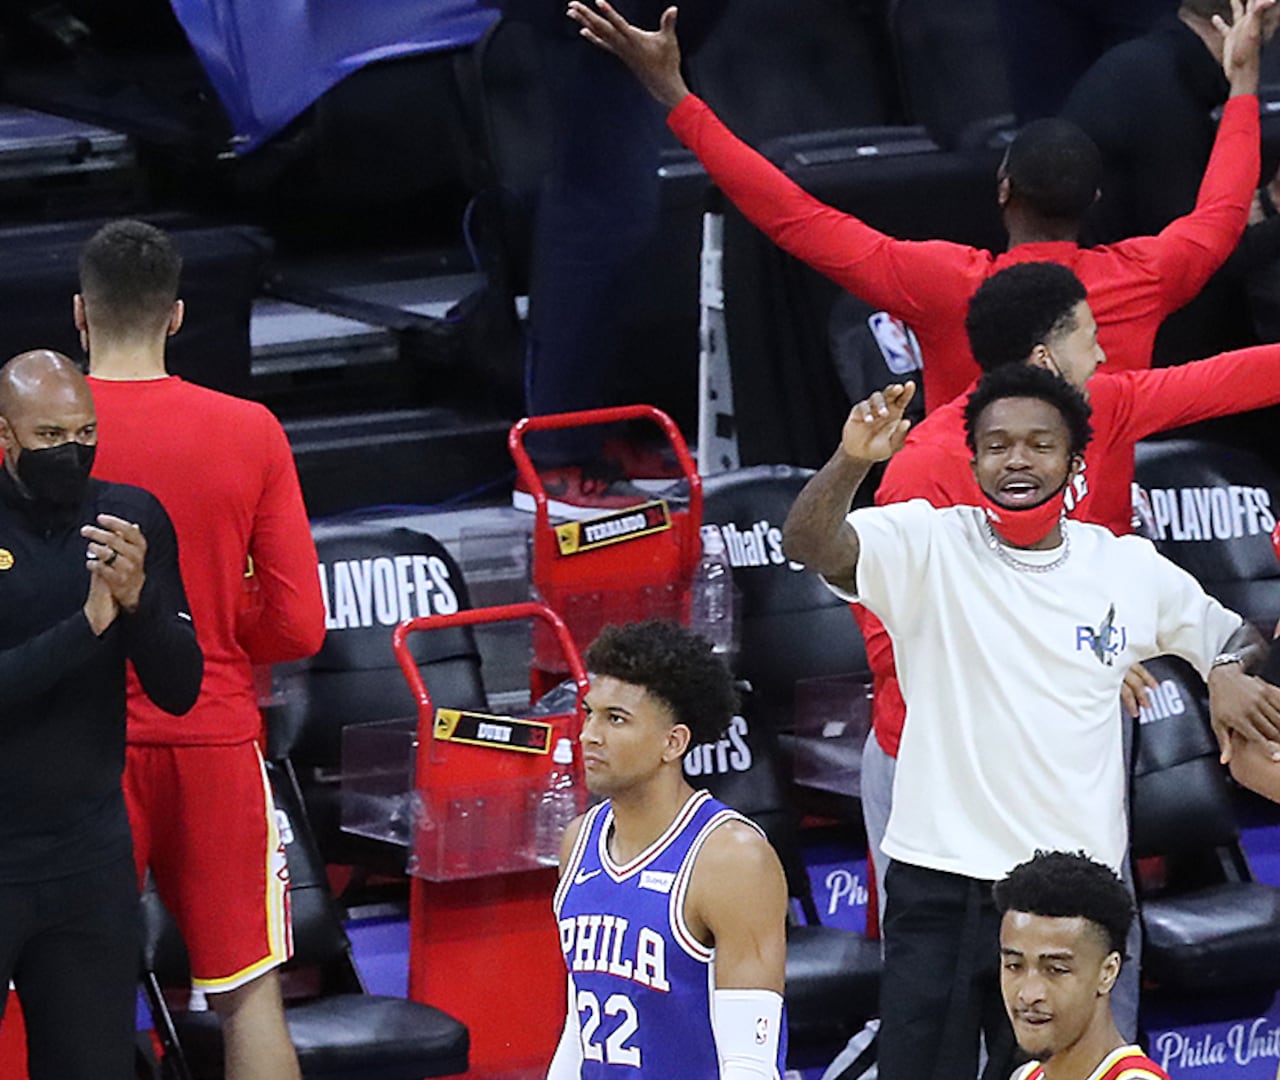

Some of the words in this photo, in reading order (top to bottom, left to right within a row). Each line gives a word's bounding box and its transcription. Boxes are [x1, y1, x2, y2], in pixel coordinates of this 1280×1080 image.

[721, 520, 786, 567] that's
[1150, 485, 1276, 541] PLAYOFFS
[318, 556, 458, 630] LAYOFFS
[560, 915, 671, 992] PHILA
[577, 990, 642, 1068] 22
[1156, 1031, 1227, 1073] Phila
